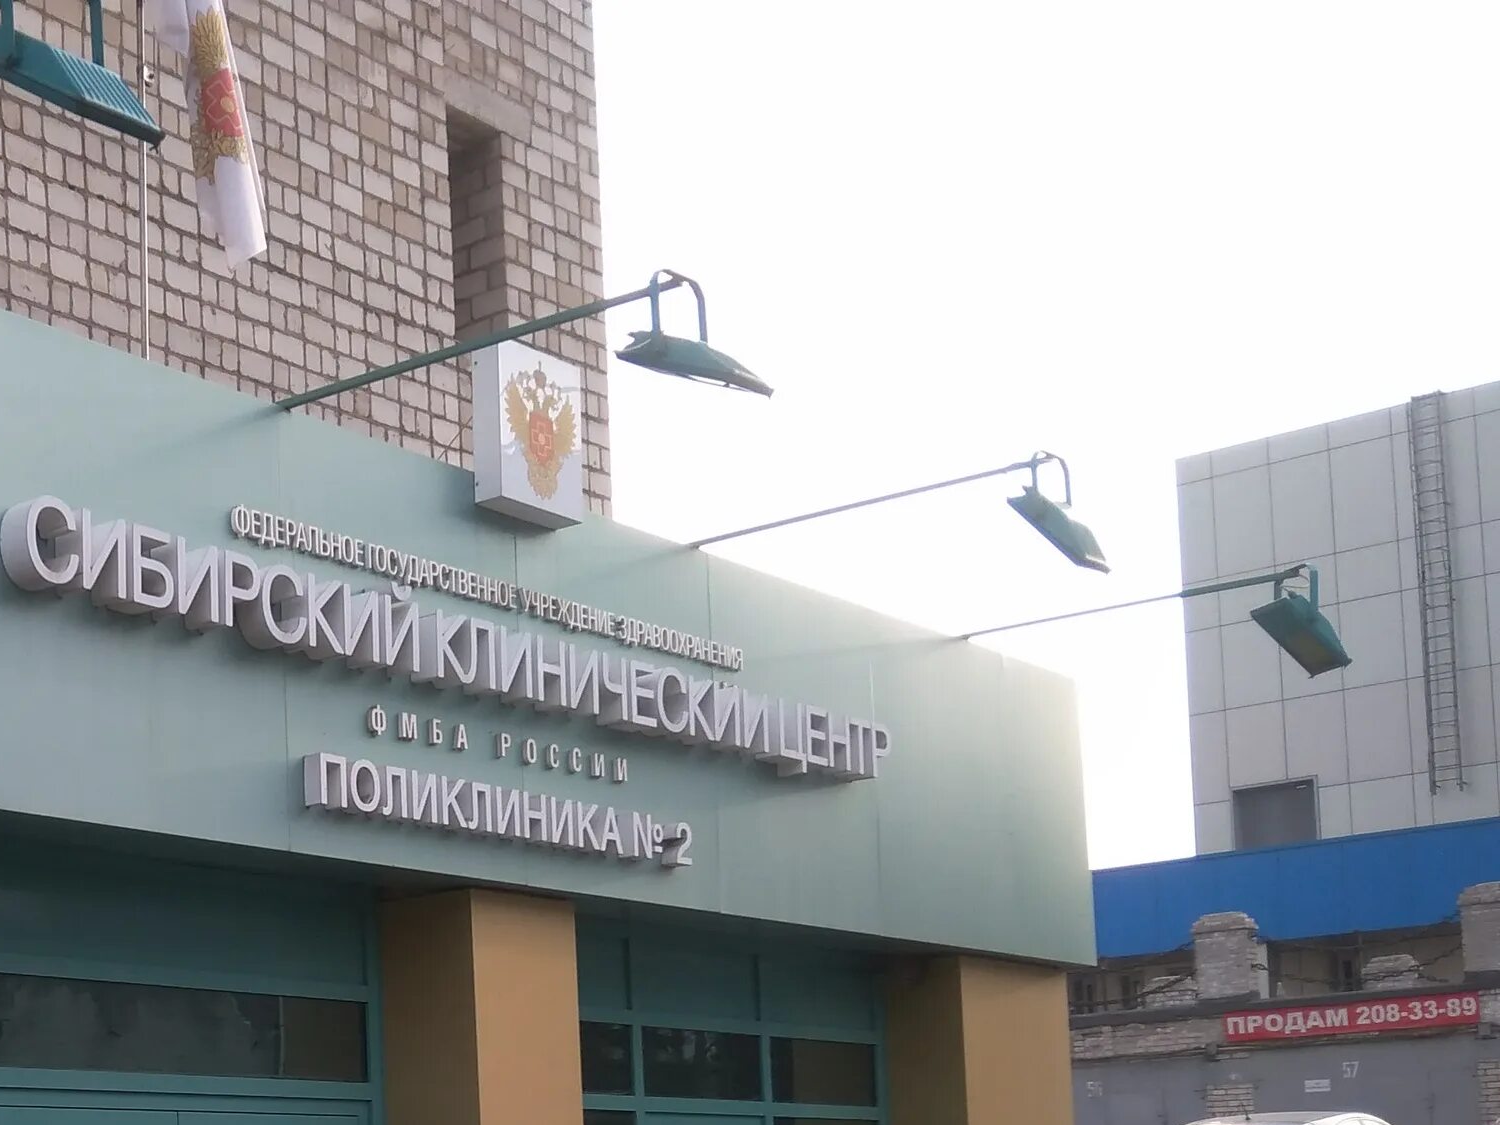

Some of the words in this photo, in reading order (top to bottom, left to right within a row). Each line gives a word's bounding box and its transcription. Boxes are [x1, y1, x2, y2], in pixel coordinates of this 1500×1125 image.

[230, 504, 366, 566] ФЕДЕРАЛЬНОЕ
[367, 542, 518, 610] ГОСУДАРСТВЕННОЕ
[522, 585, 617, 638] УЧРЕЖДЕНИЕ
[615, 614, 744, 672] ЗДРАВООХРАНЕНИЯ
[22, 497, 420, 673] СИБИРСКИЙ
[777, 697, 892, 778] ЦЕНТР
[367, 703, 469, 751] ФМБА
[497, 732, 629, 783] РОССИИ
[319, 751, 624, 856] ПОЛИКЛИНИКА
[632, 811, 664, 860] №
[676, 822, 693, 866] 2
[1227, 1007, 1349, 1035] ПРОДАМ
[1356, 997, 1477, 1025] 208-33-89
[1342, 1061, 1359, 1078] 57
